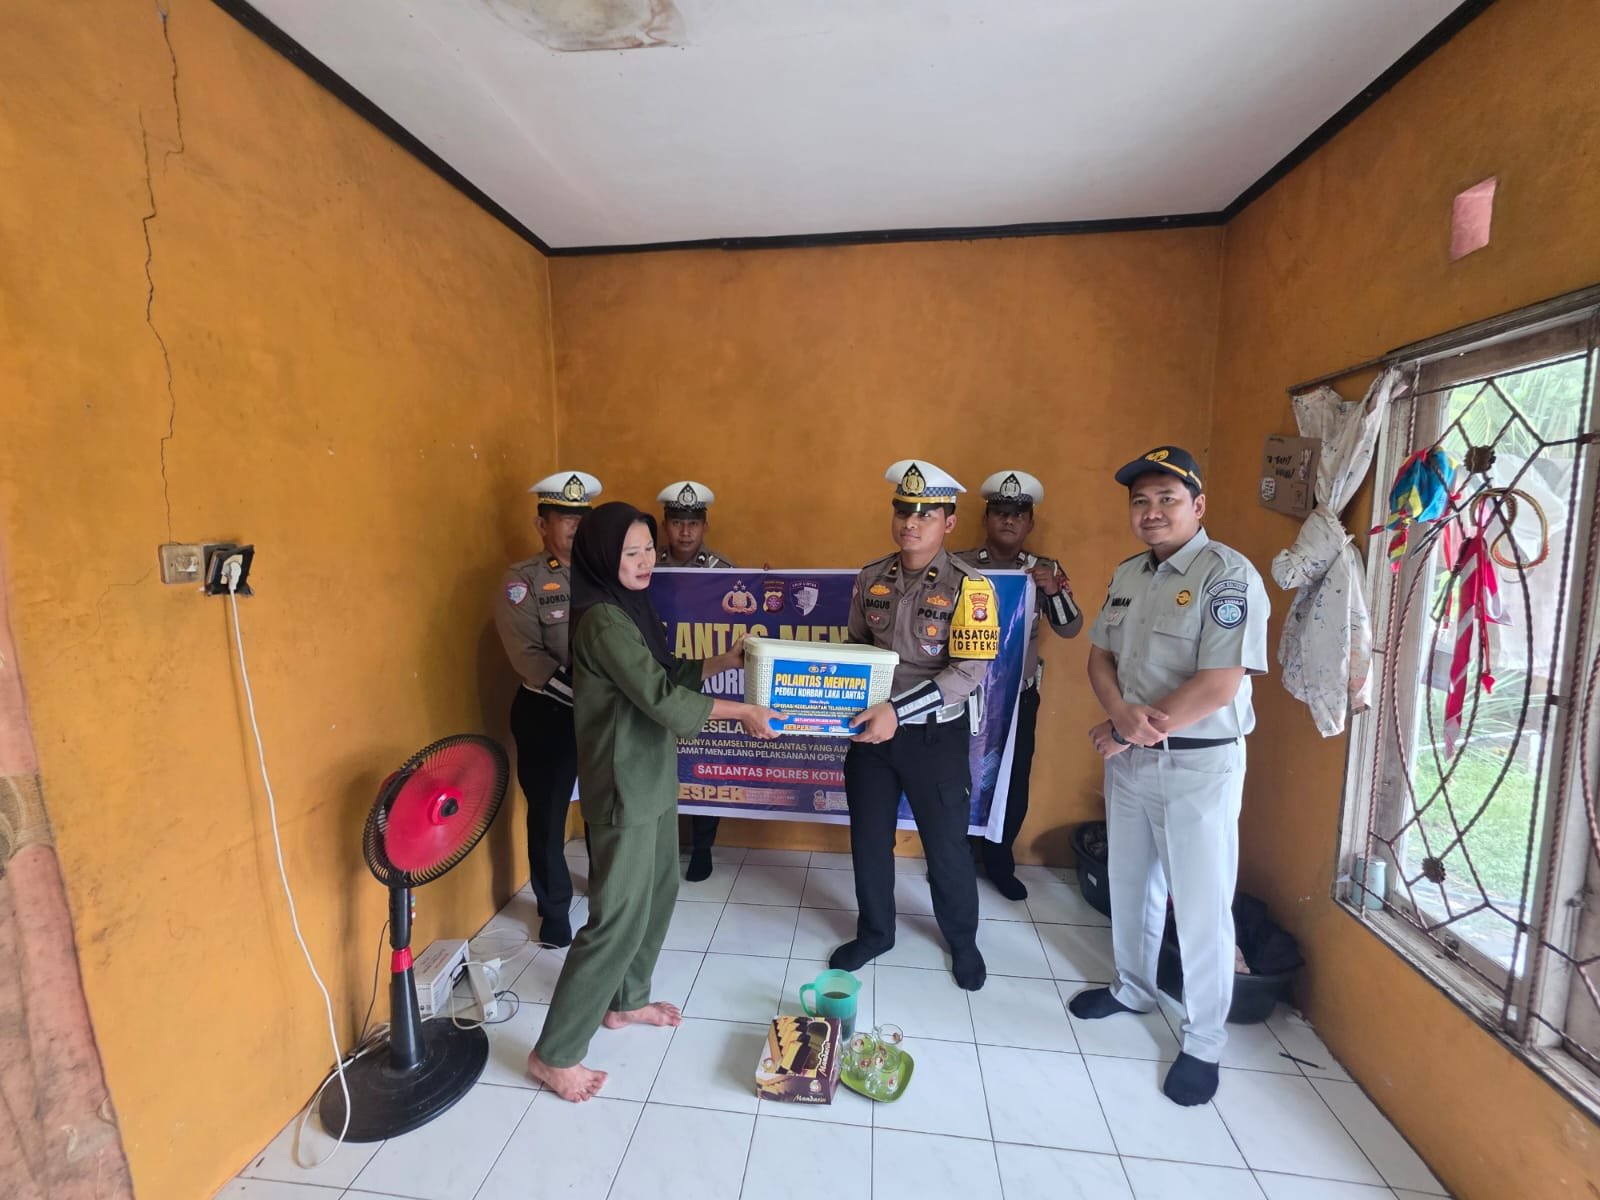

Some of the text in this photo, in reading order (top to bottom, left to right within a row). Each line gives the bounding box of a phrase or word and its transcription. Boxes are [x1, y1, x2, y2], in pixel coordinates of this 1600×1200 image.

[865, 599, 890, 610] BAGUS
[952, 629, 998, 640] KASATGAS
[775, 674, 866, 690] POLANTAS MENYAPA
[774, 687, 865, 700] PEDULI KORBAN LAKA LANTAS
[711, 739, 806, 751] KAMSELTIBCARLANTAS
[808, 744, 833, 752] YANG
[705, 748, 754, 757] MENJELANG
[755, 751, 816, 761] PELAKSANAAN
[817, 753, 835, 762] OPS
[697, 764, 763, 777] SATLANTAS
[765, 769, 809, 780] POLRES
